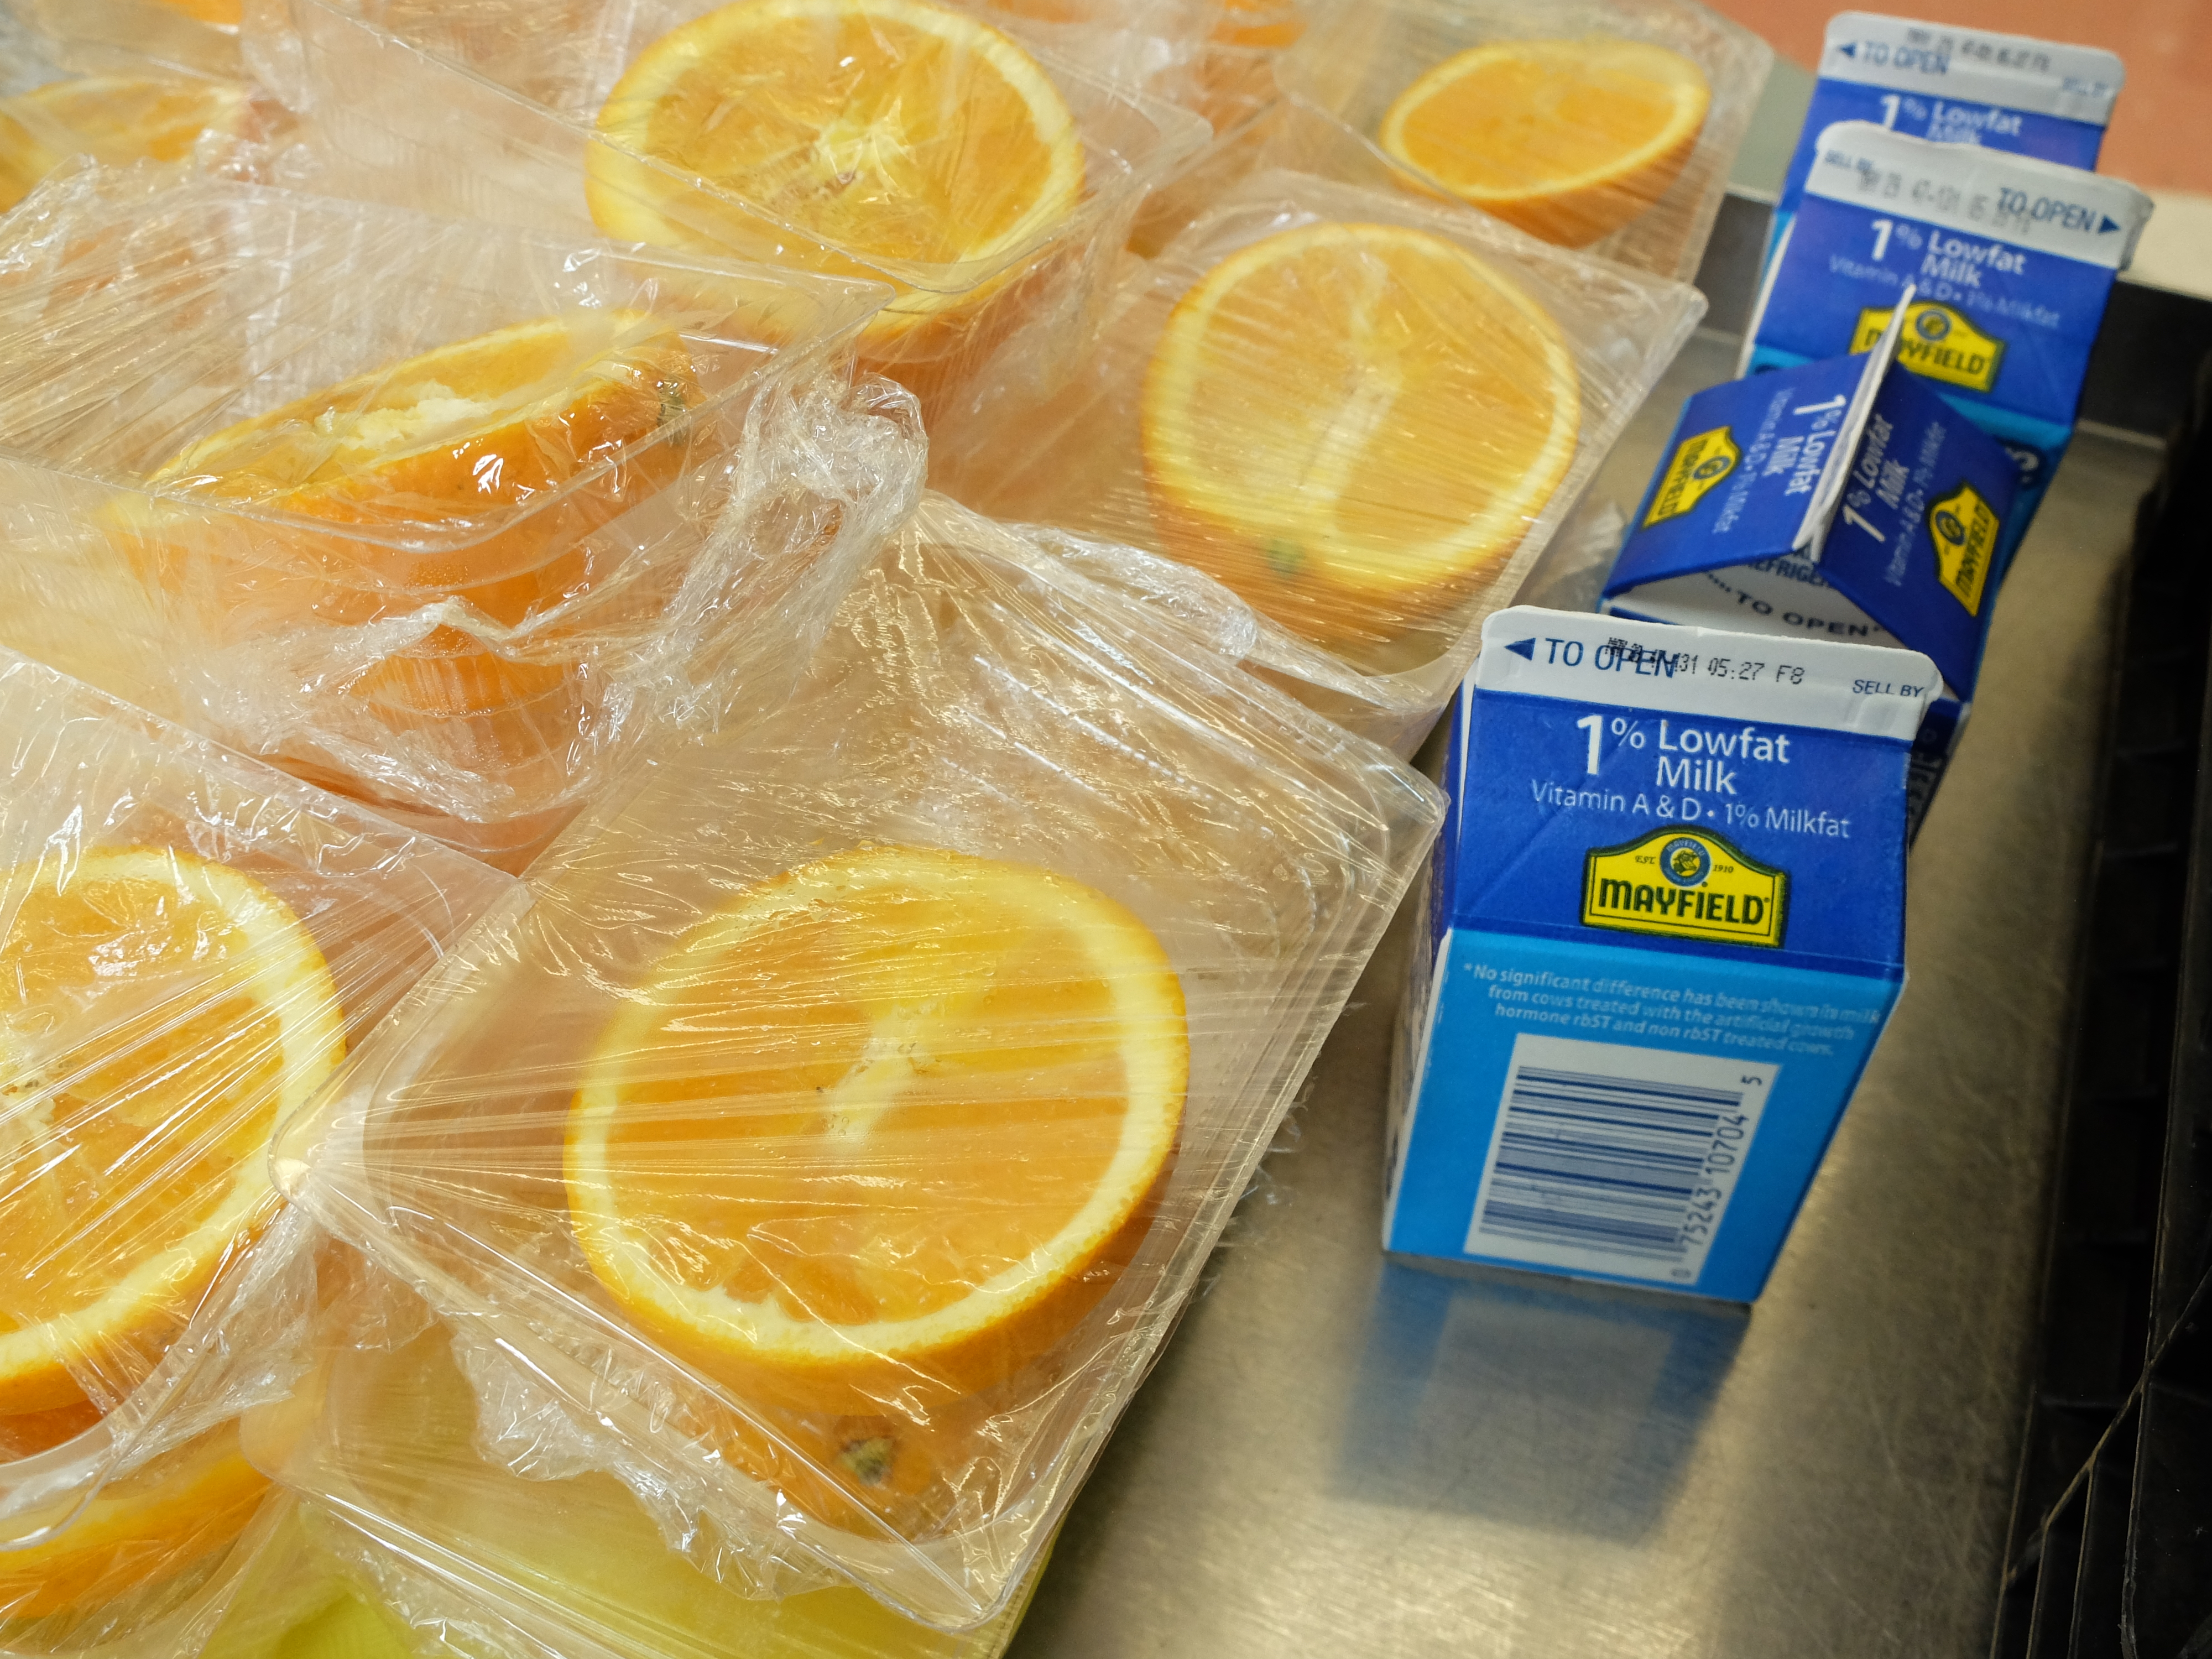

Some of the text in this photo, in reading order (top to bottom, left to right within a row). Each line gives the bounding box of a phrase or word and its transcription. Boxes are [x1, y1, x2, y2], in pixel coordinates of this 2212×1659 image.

[1864, 40, 1890, 66] TO
[1893, 46, 1952, 75] OPEN
[1931, 100, 2022, 137] Lowfat
[1997, 187, 2028, 214] TO
[2031, 196, 2097, 231] OPEN
[1871, 219, 2027, 275] 1% Lowfat
[1920, 253, 1983, 288] Milk
[1864, 327, 1985, 375] MYFIELD
[1761, 435, 1805, 477] Milk
[1784, 394, 1846, 497] 1% Lowfat
[1658, 439, 1708, 517] MAYFIELD
[1842, 413, 1893, 543] 1% Lowfat
[1875, 459, 1910, 510] Milk
[1955, 503, 1990, 598] MAYFIELD
[1738, 589, 1869, 637] TO OPEN
[1545, 637, 1584, 667] TO
[1594, 644, 1681, 679] OPEN
[1707, 656, 1765, 681] 05:27
[1775, 664, 1806, 685] F8
[1852, 679, 1925, 697] SELL BY
[1576, 714, 1791, 775] 1% Lowfat
[1656, 755, 1738, 795] Milk
[1531, 778, 1851, 839] Vitamin A & D 1% Milkfat
[1713, 864, 1734, 874] 1910
[1598, 877, 1765, 926] MAYFIELD
[1488, 984, 1854, 1041] from cows treated with the artificial growth
[1500, 968, 1591, 992] significant
[1592, 978, 1681, 1003] difference
[1683, 988, 1713, 1006] has
[1715, 992, 1760, 1010] been
[1760, 998, 1819, 1018] shown
[1820, 1003, 1839, 1020] in
[1839, 1007, 1881, 1024] milk
[1495, 1003, 1571, 1025] hormone
[1573, 1012, 1613, 1029] rbST
[1613, 1020, 1648, 1035] and
[1648, 1022, 1681, 1038] non
[1683, 1027, 1723, 1042] rbST
[1723, 1031, 1790, 1050] treated
[1740, 1074, 1763, 1087] 5
